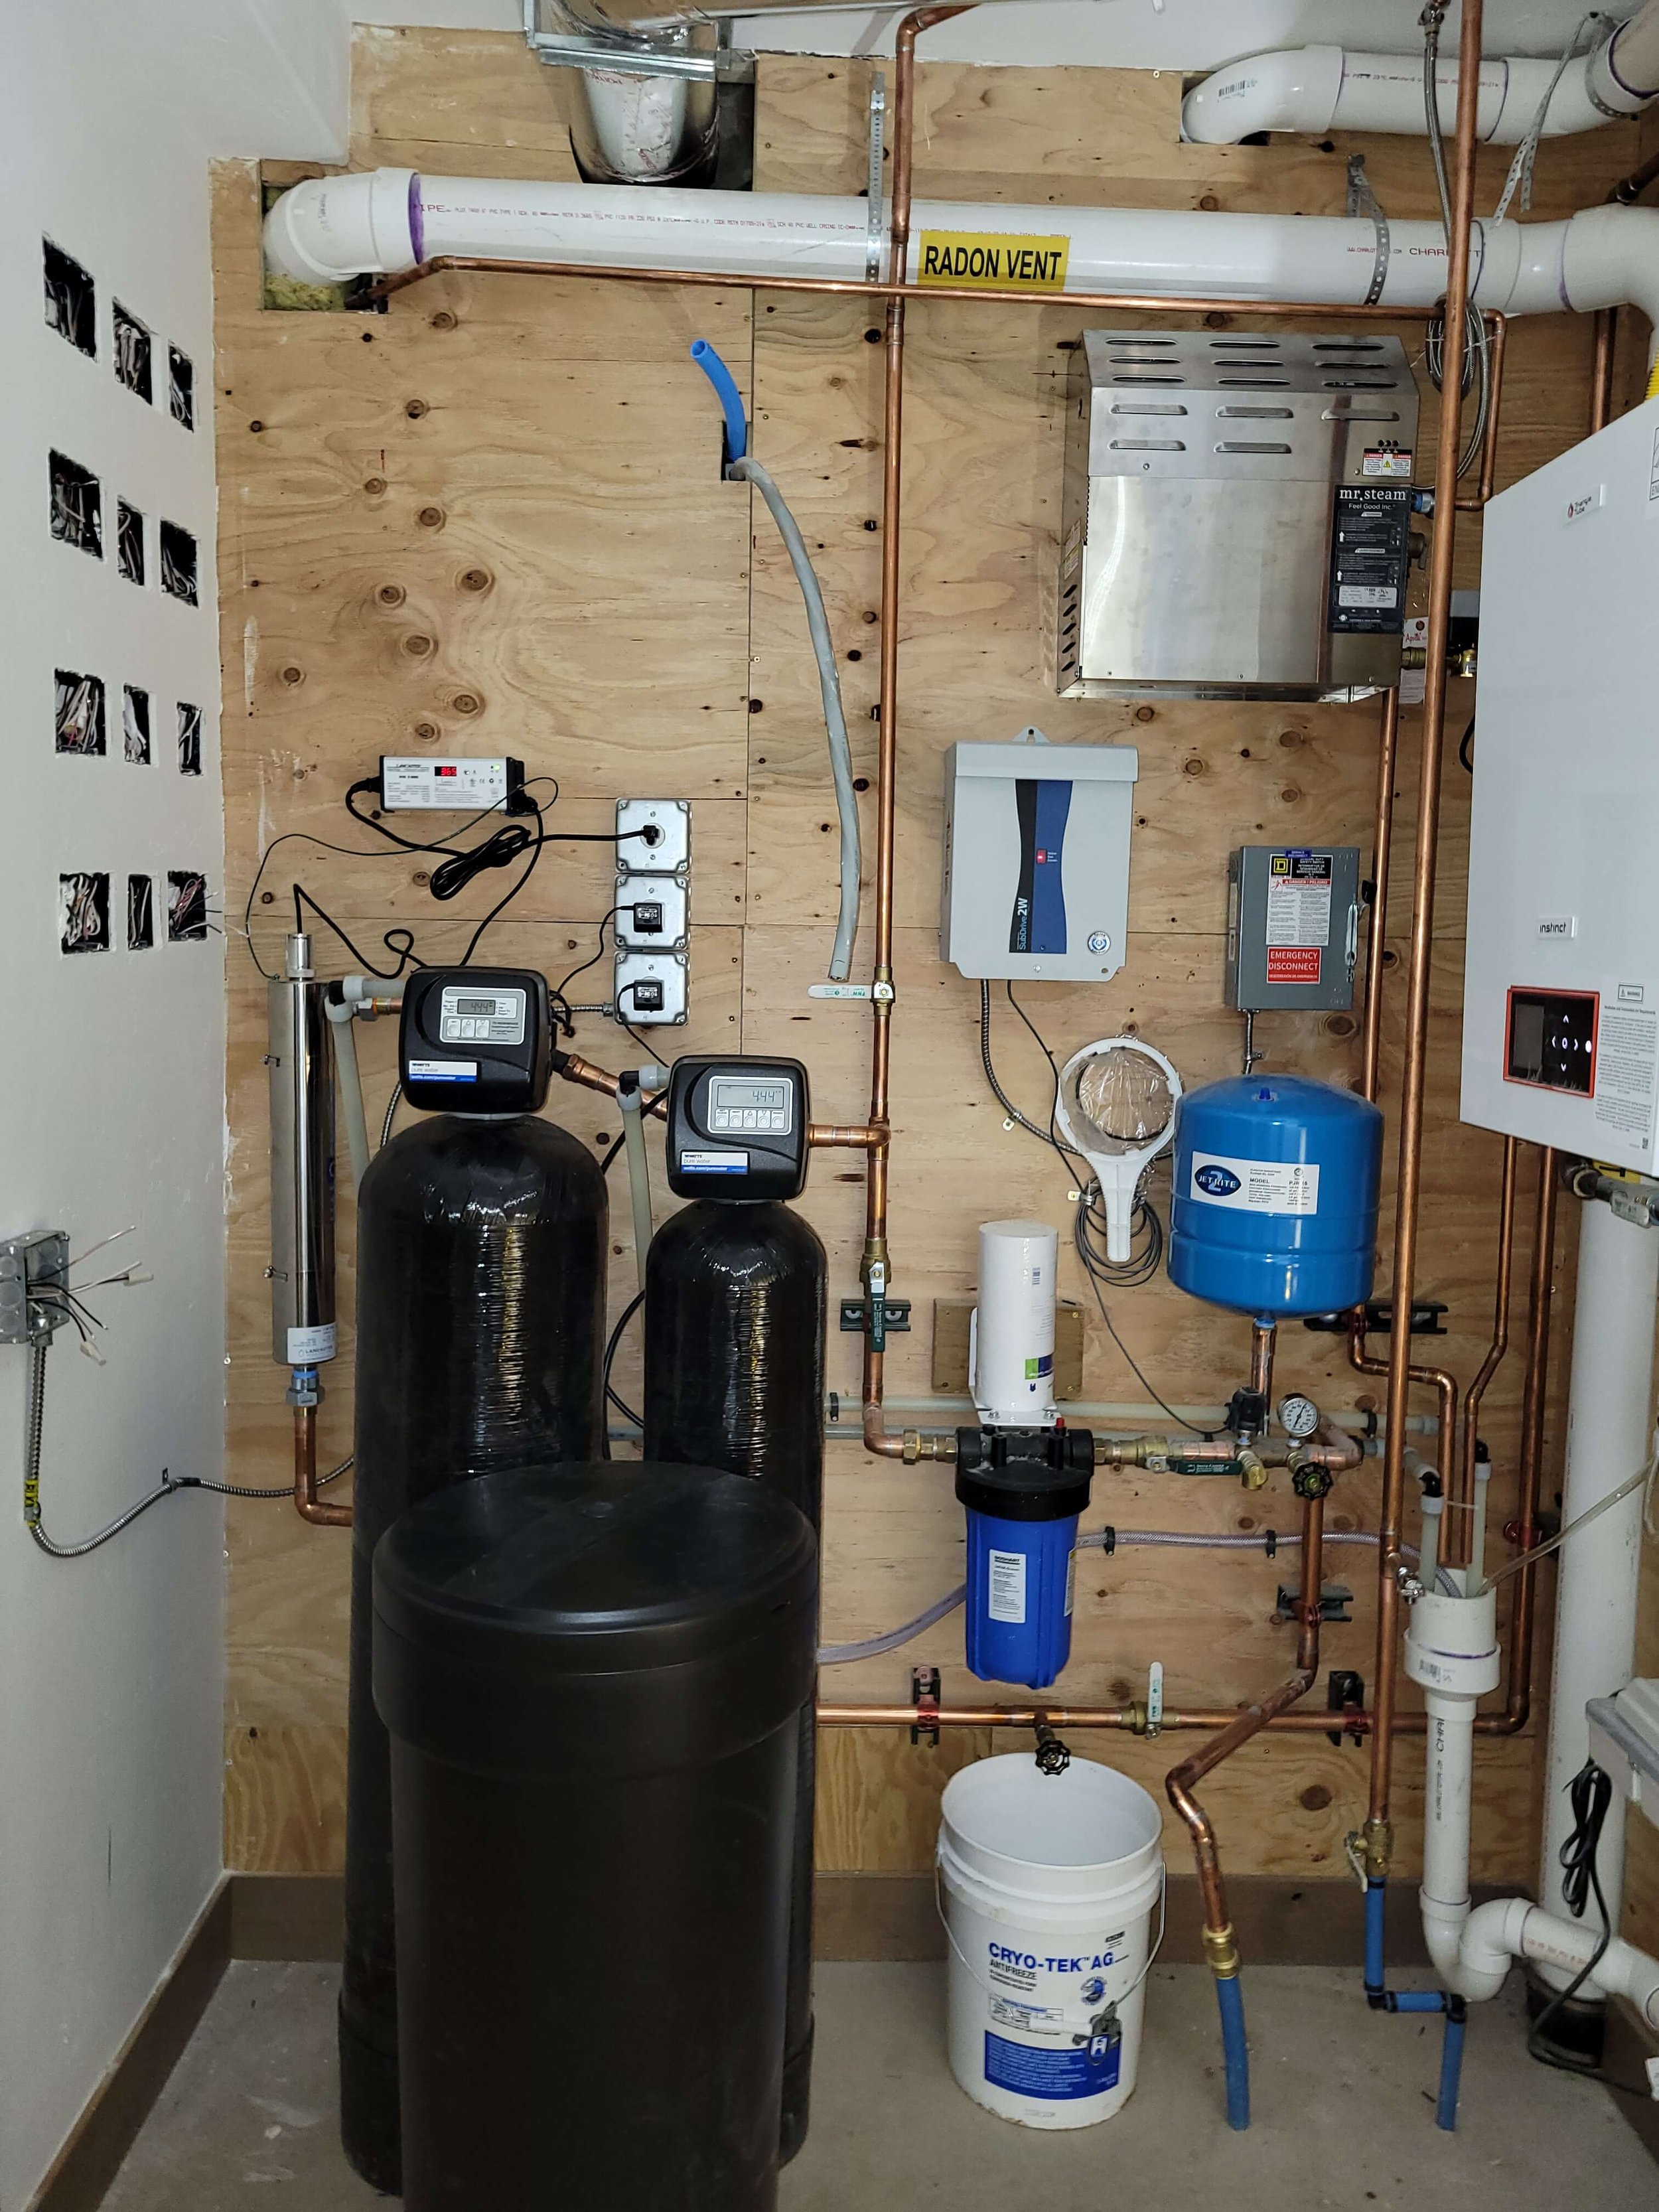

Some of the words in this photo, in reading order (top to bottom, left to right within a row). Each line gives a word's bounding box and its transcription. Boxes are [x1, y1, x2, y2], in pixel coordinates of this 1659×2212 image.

[924, 245, 1000, 277] RADON
[1007, 249, 1062, 281] VENT
[1339, 488, 1407, 501] mr.steam
[440, 767, 457, 776] 365
[1270, 951, 1318, 960] EMERGENCY
[1268, 962, 1319, 971] DISCONNECT
[753, 1090, 774, 1102] 444
[1198, 1175, 1213, 1183] JET
[1090, 1952, 1114, 1970] AG
